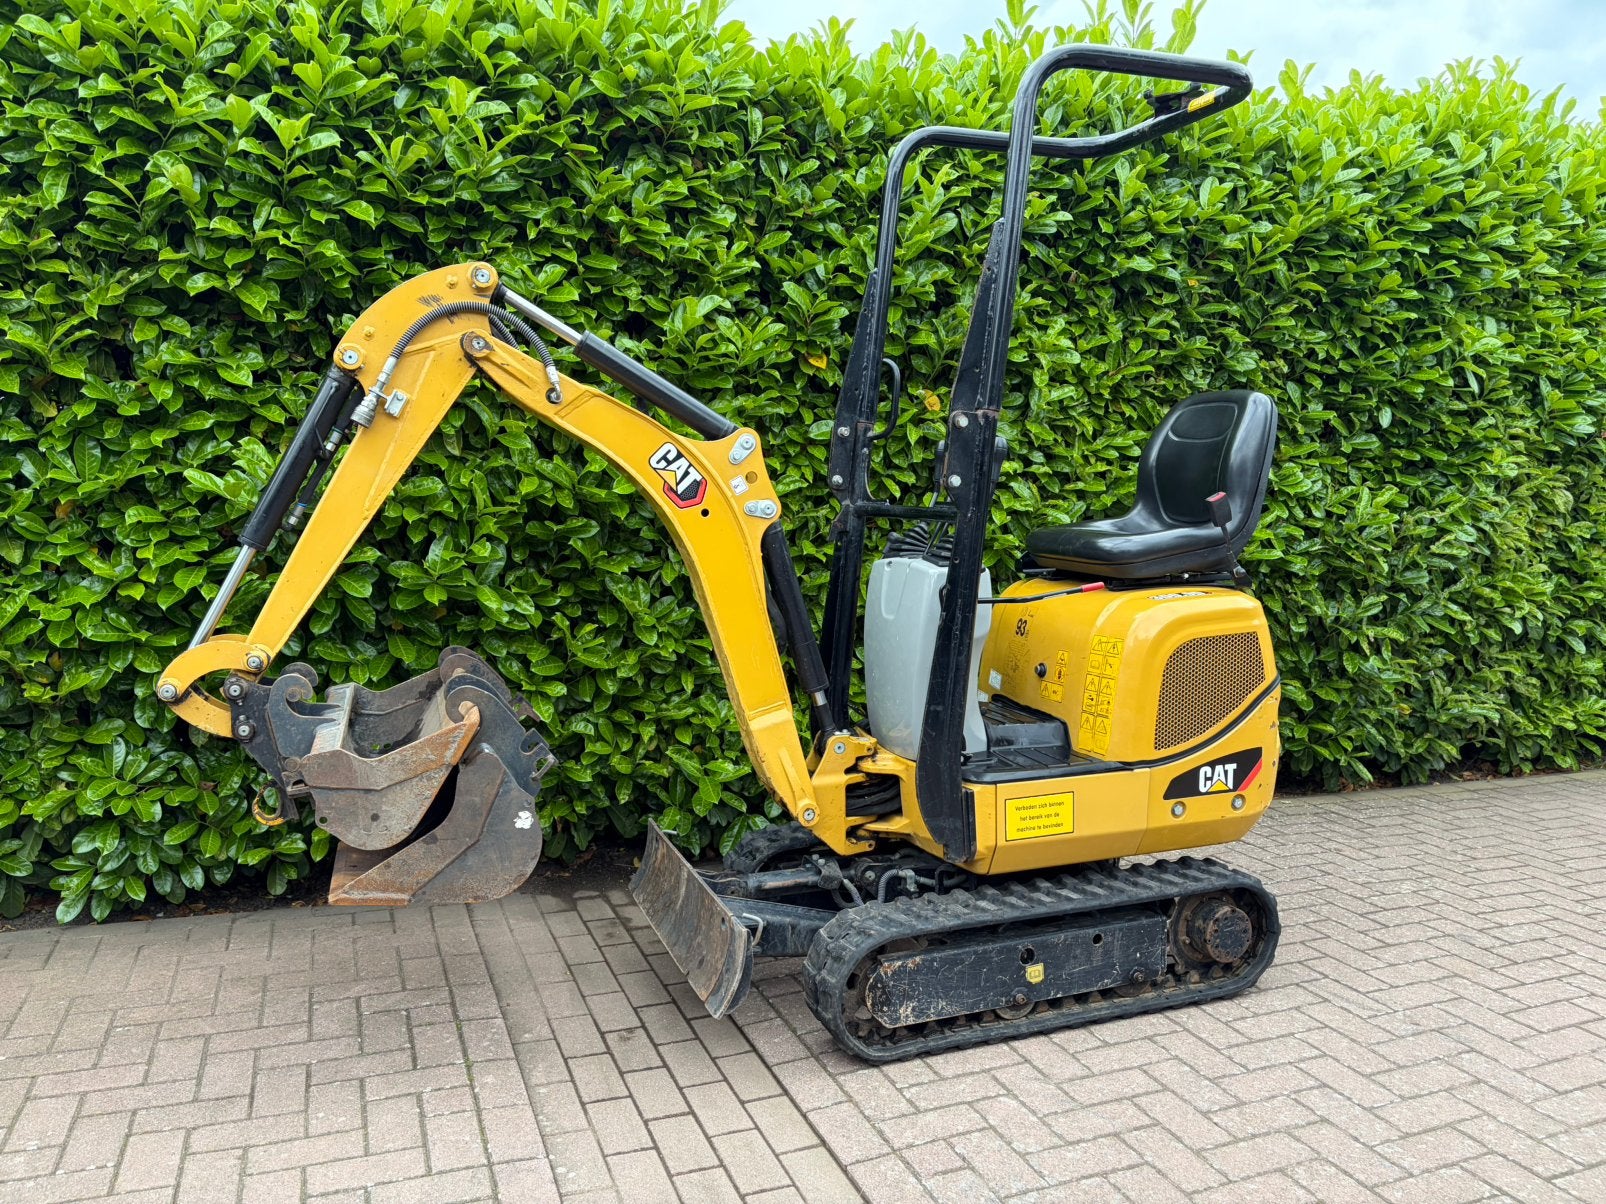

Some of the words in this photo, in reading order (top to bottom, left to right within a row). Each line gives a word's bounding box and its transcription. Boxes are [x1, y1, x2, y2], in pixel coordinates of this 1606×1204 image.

[650, 442, 702, 494] CAT
[1016, 618, 1028, 636] 93
[1199, 763, 1237, 792] CAT
